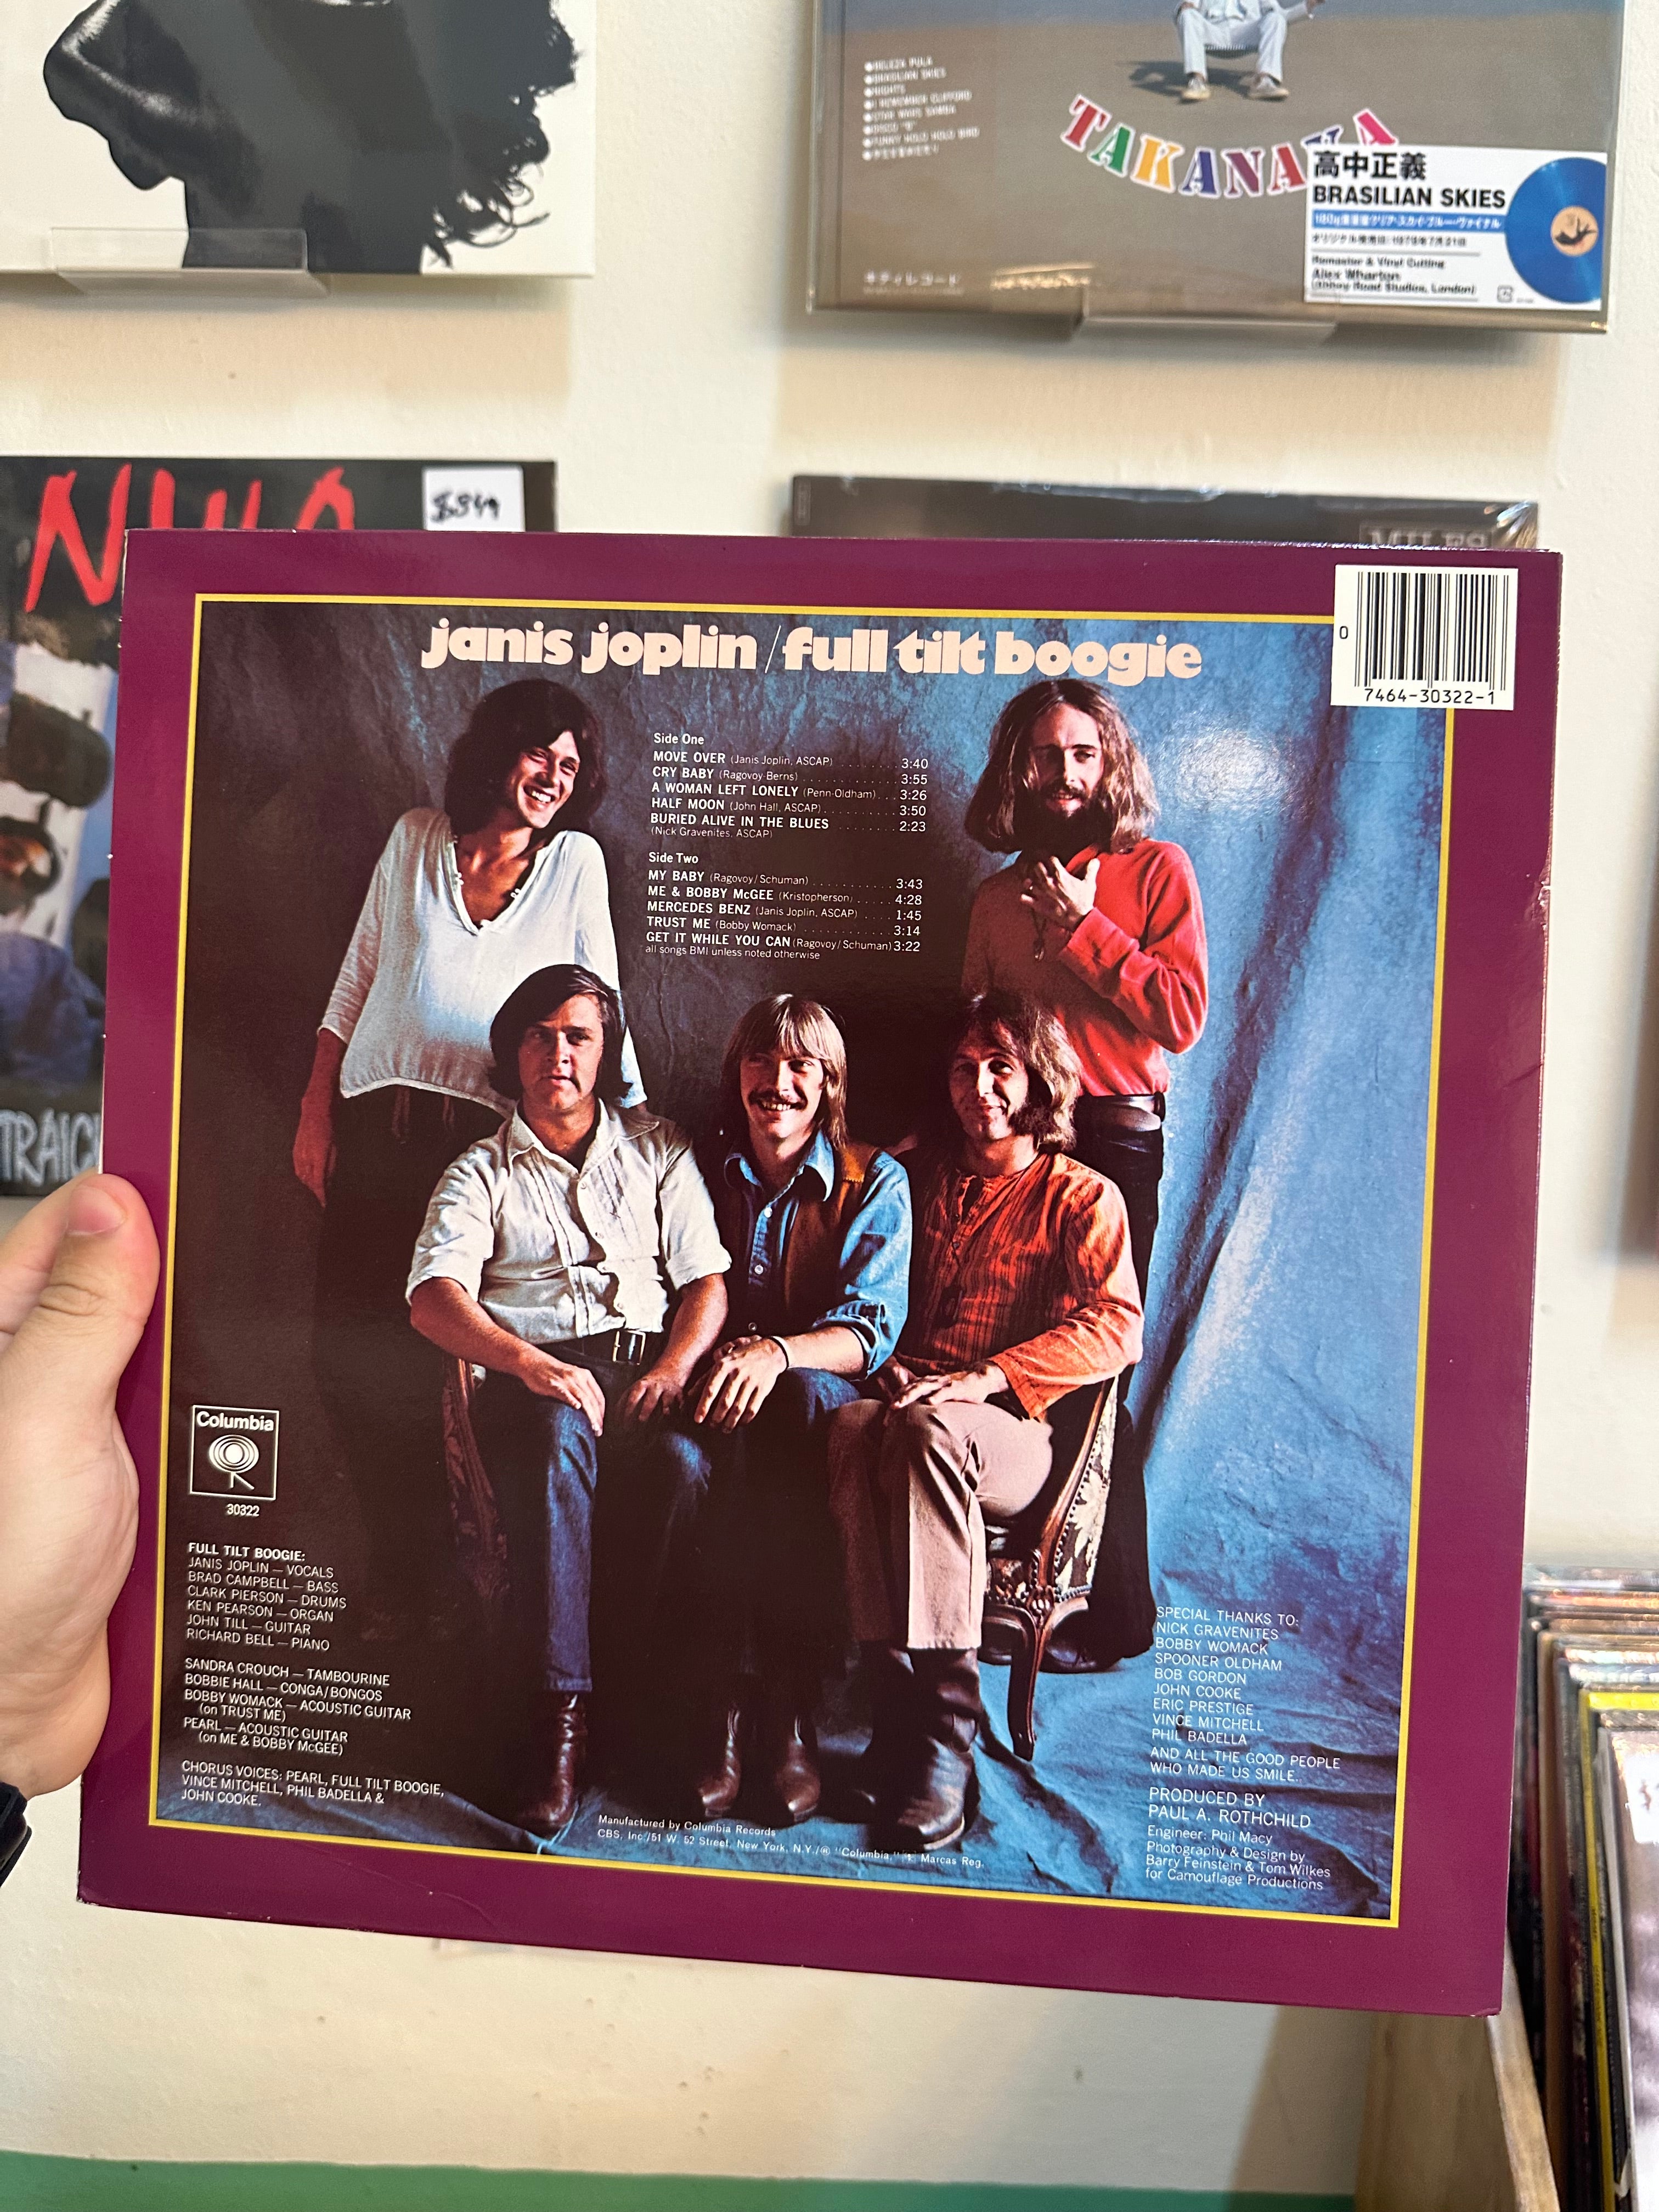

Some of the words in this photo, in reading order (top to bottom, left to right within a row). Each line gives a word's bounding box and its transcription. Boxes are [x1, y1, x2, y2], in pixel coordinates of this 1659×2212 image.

[1314, 151, 1427, 180] 高中正義
[1313, 186, 1431, 206] BRASILIAN
[1441, 189, 1506, 208] SKIES
[1365, 257, 1374, 266] &
[1339, 625, 1349, 639] 0
[421, 618, 573, 669] janis
[582, 622, 757, 675] joplin
[782, 627, 889, 673] full
[893, 630, 986, 675] tilt
[994, 631, 1202, 687] boogie
[1364, 687, 1495, 706] 7464-30322-1
[653, 732, 679, 744] Side
[681, 733, 704, 745] One
[653, 751, 688, 763] MOVE
[693, 751, 726, 764] OVER
[731, 754, 759, 764] (Janis
[761, 755, 793, 766] Joplin,
[795, 756, 833, 766] ASCAP)
[901, 758, 929, 769] 3:40
[652, 766, 678, 777] CRY
[680, 767, 714, 779] BABY
[719, 769, 798, 782] (Ragovoy-Berns)
[901, 773, 928, 785] 3:55
[651, 782, 660, 793] A
[665, 782, 712, 794] WOMAN
[718, 783, 747, 795] LEFT
[752, 785, 799, 797] LONELY
[803, 788, 876, 799] (Penn-Oldham)
[899, 789, 927, 801] 3:26
[651, 797, 682, 809] HALF
[687, 798, 725, 810] MOON
[730, 801, 757, 811] (John
[759, 802, 781, 812] Hall,
[784, 803, 821, 814] ASCAP)
[899, 805, 926, 816] 3:50
[650, 812, 697, 825] BURIED
[701, 814, 736, 826] ALIVE
[741, 816, 753, 827] IN
[759, 816, 783, 828] THE
[789, 817, 829, 830] BLUES
[899, 821, 926, 832] 2:23
[651, 826, 677, 836] (Nick
[679, 826, 733, 838] Gravenites,
[736, 828, 772, 838] ASCAP)
[648, 851, 674, 863] Side
[675, 852, 699, 864] Two
[648, 870, 667, 881] MY
[672, 870, 704, 882] BABY
[896, 878, 923, 889] 3:43
[648, 885, 666, 896] ME
[671, 886, 680, 897] &
[686, 887, 728, 899] BOBBY
[733, 888, 774, 900] McGEE
[895, 894, 922, 905] 4:28
[647, 900, 713, 914] MERCEDES
[719, 903, 751, 915] BENZ
[755, 906, 784, 916] (Janis
[786, 907, 818, 918] Joplin,
[821, 908, 857, 918] ASCAP)
[896, 910, 922, 921] 1:45
[646, 916, 687, 928] TRUST
[692, 918, 711, 929] ME
[715, 919, 749, 932] (Bobby
[752, 921, 796, 932] Womack)
[894, 925, 921, 936] 3:14
[646, 931, 670, 943] GET
[675, 932, 687, 943] IT
[691, 933, 730, 945] WHILE
[735, 934, 760, 946] YOU
[765, 935, 791, 947] CAN
[893, 940, 921, 952] 3:22
[196, 1410, 275, 1431] Columbia
[227, 1503, 260, 1516] 30322
[188, 1542, 219, 1555] FULL
[223, 1545, 251, 1558] TILT
[255, 1547, 306, 1562] BOOGIE:
[188, 1556, 223, 1570] JANIS
[225, 1560, 269, 1574] JOPLIN
[286, 1564, 334, 1579] VOCALS
[188, 1570, 222, 1584] BRAD
[225, 1573, 290, 1590] CAMPBELL
[307, 1580, 339, 1595] BASS
[187, 1584, 227, 1599] CLARK
[230, 1589, 284, 1604] PIERSON
[301, 1594, 347, 1610] DRUMS
[187, 1599, 211, 1612] KEN
[216, 1601, 273, 1617] PEARSON
[290, 1608, 334, 1622] ORGAN
[1155, 1606, 1211, 1622] SPECIAL
[1216, 1610, 1272, 1626] THANKS
[1277, 1613, 1299, 1628] TO:
[187, 1613, 219, 1627] JOHN
[223, 1617, 249, 1630] TILL
[264, 1620, 311, 1635] GUITAR
[1155, 1621, 1189, 1635] NICK
[1194, 1623, 1279, 1642] GRAVENITES
[187, 1628, 241, 1644] RICHARD
[245, 1633, 275, 1646] BELL
[291, 1637, 330, 1651] PIANO
[1154, 1637, 1202, 1651] BOBBY
[1207, 1640, 1268, 1656] WOMACK
[1154, 1652, 1219, 1668] SPOONER
[1224, 1656, 1282, 1672] OLDHAM
[1154, 1667, 1183, 1681] BOB
[1188, 1669, 1247, 1686] GORDON
[1153, 1683, 1190, 1697] JOHN
[1195, 1685, 1242, 1701] COOKE
[1153, 1697, 1184, 1712] ERIC
[1189, 1700, 1254, 1716] PRESTIGE
[1152, 1713, 1193, 1728] VINCE
[1198, 1716, 1264, 1733] MITCHELL
[1152, 1728, 1183, 1744] PHIL
[1188, 1730, 1248, 1747] BADELLA
[1150, 1746, 1181, 1762] AND
[1184, 1748, 1208, 1762] ALL
[1214, 1750, 1240, 1766] THE
[1245, 1752, 1285, 1767] GOOD
[1290, 1754, 1341, 1770] PEOPLE
[1150, 1761, 1183, 1776] WHO
[1187, 1763, 1226, 1779] MADE
[1232, 1766, 1251, 1781] US
[1255, 1768, 1302, 1783] SMILE.
[1149, 1786, 1239, 1807] PRODUCED
[1244, 1793, 1265, 1808] BY
[598, 1814, 665, 1829] Manufactured
[668, 1819, 681, 1832] by
[684, 1821, 731, 1833] Columbia
[735, 1824, 776, 1838] Records
[1148, 1804, 1189, 1821] PAUL
[1195, 1807, 1211, 1822] A.
[1219, 1809, 1311, 1829] ROTHCHILD
